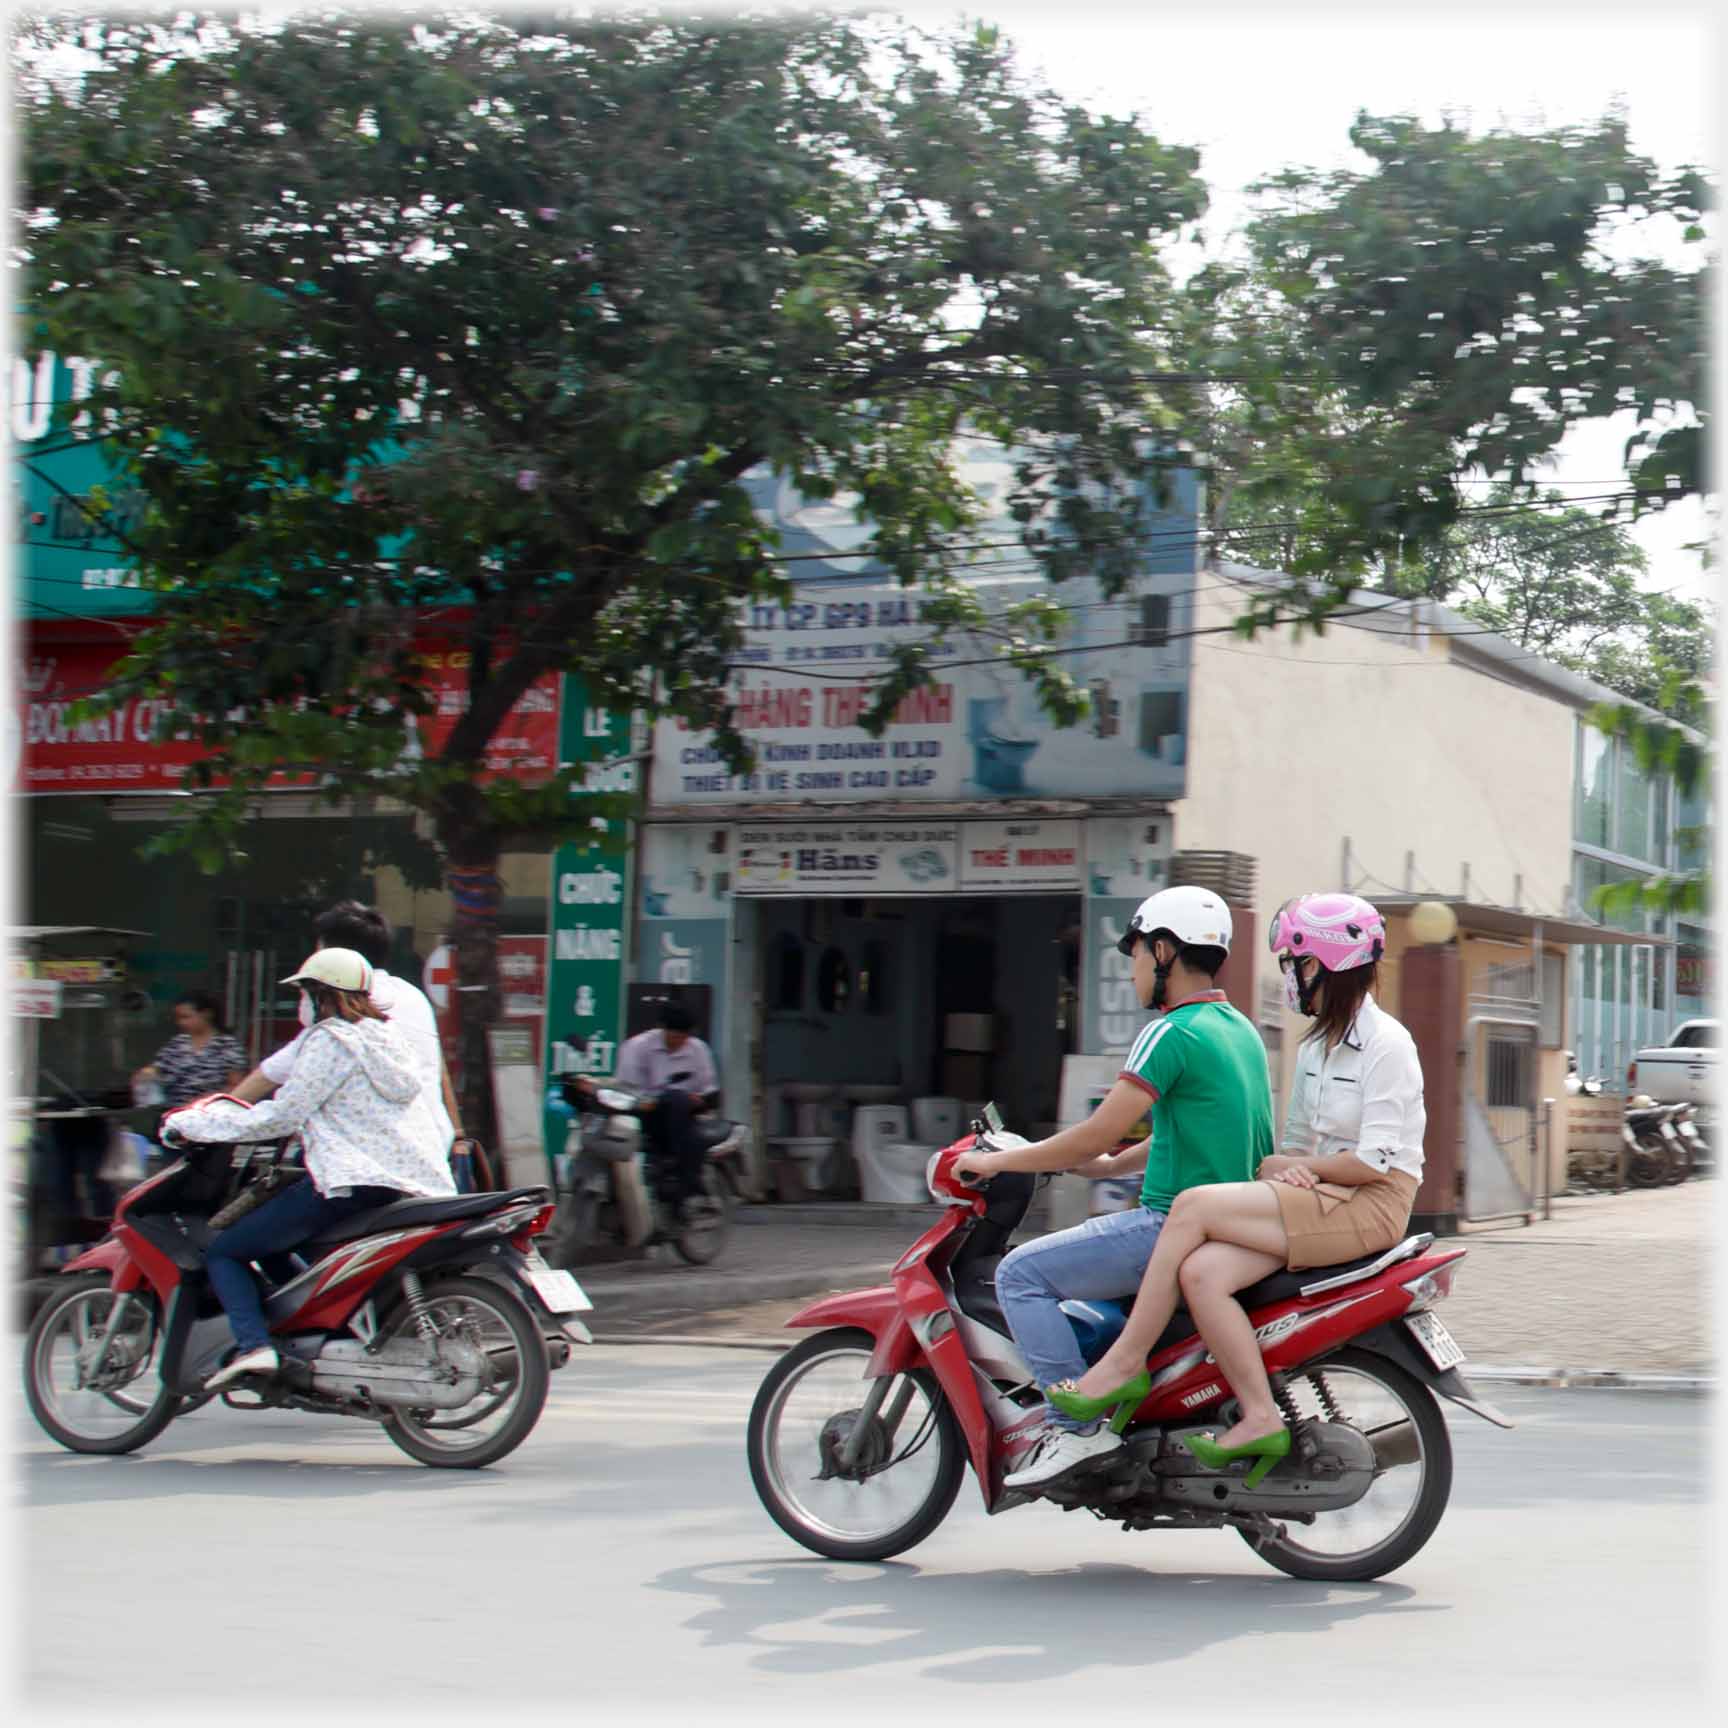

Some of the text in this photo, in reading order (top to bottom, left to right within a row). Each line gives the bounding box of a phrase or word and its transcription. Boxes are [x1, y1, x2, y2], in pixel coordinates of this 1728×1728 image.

[816, 741, 885, 760] DOANH
[796, 772, 845, 790] SINH
[574, 984, 596, 1017] &
[1181, 1384, 1223, 1408] YAMAHA
